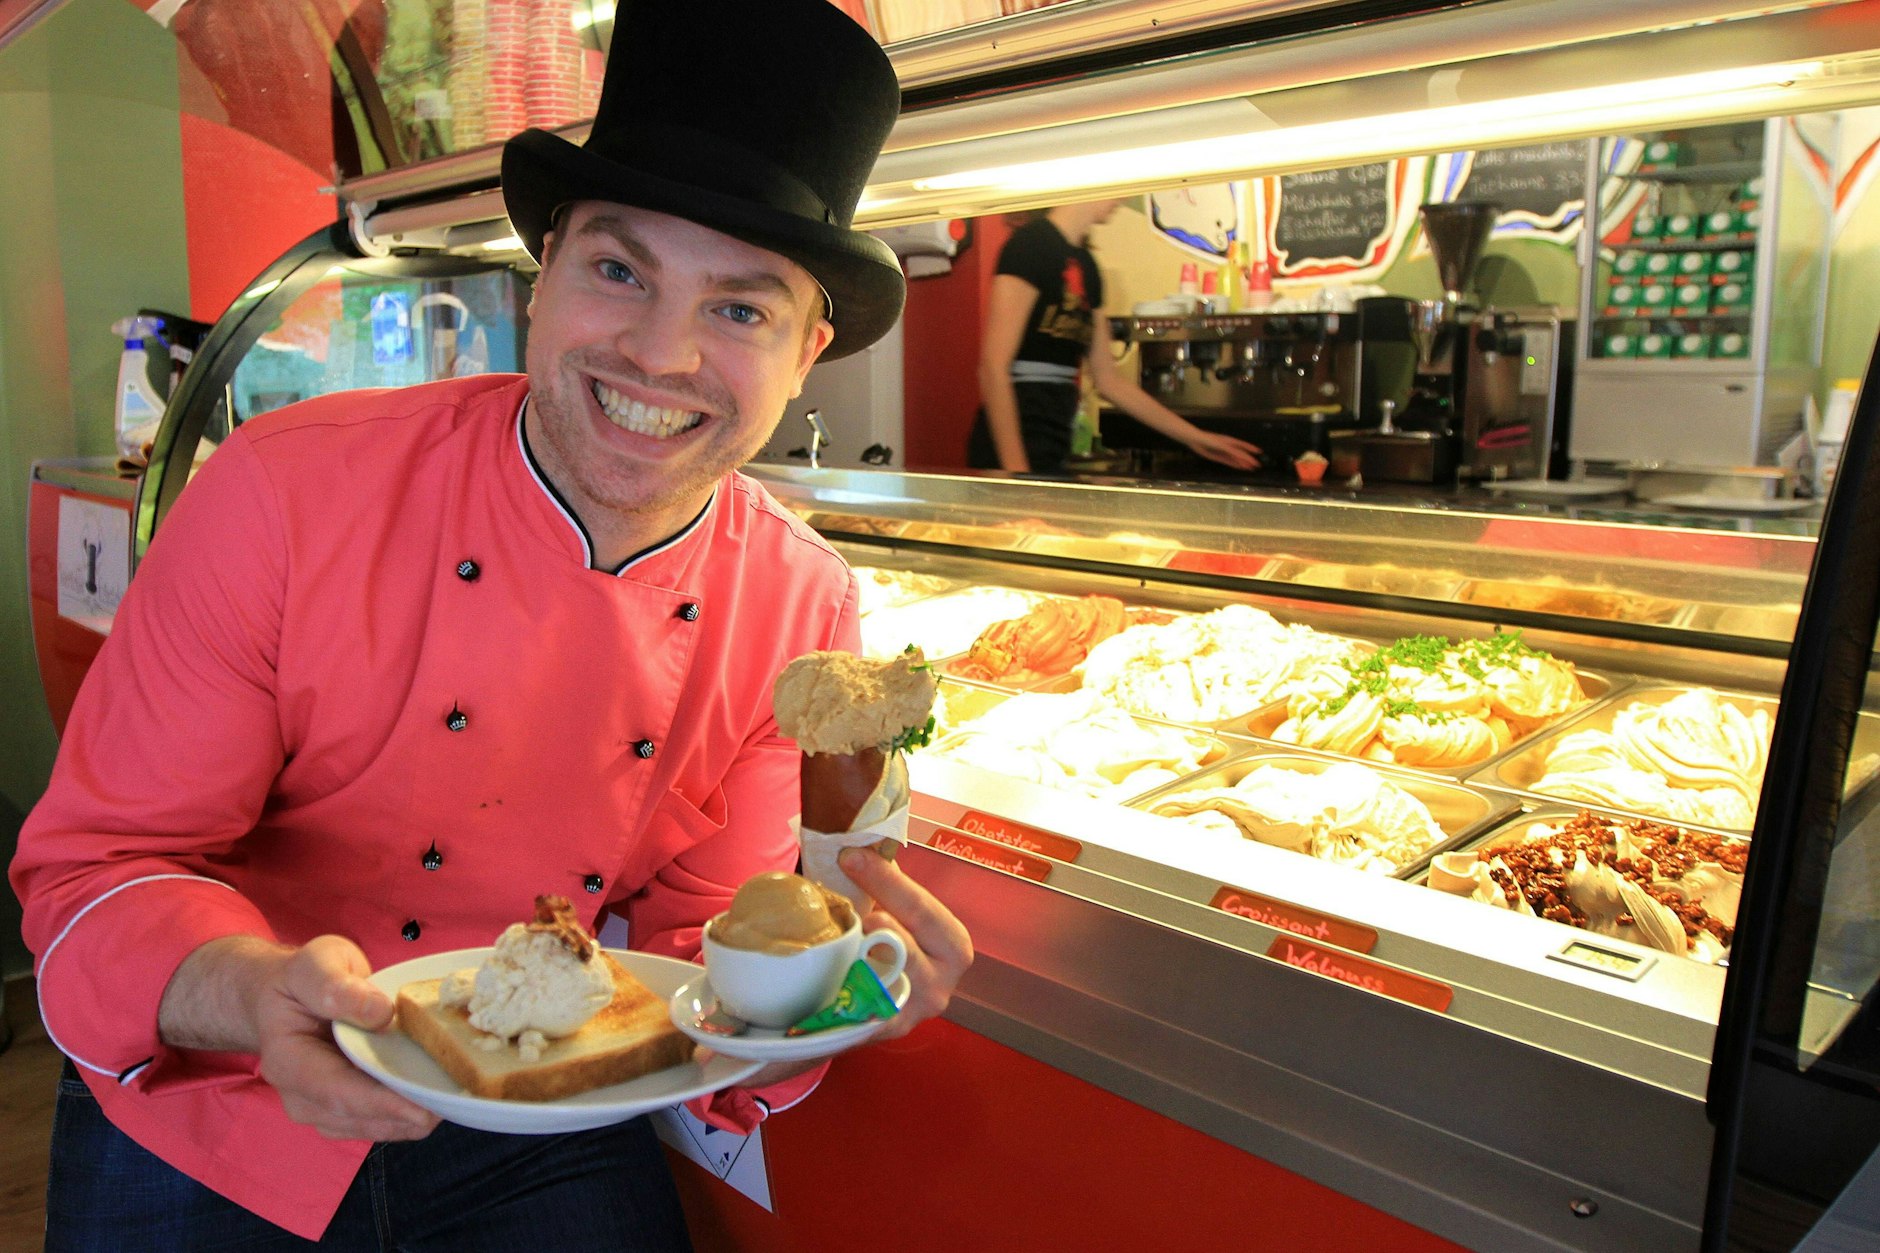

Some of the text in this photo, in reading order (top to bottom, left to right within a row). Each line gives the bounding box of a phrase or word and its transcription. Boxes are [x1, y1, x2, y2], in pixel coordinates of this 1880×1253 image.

[934, 834, 1025, 875] Weißwurst
[1220, 894, 1330, 940] Croissant
[1286, 943, 1386, 992] Walnuss
